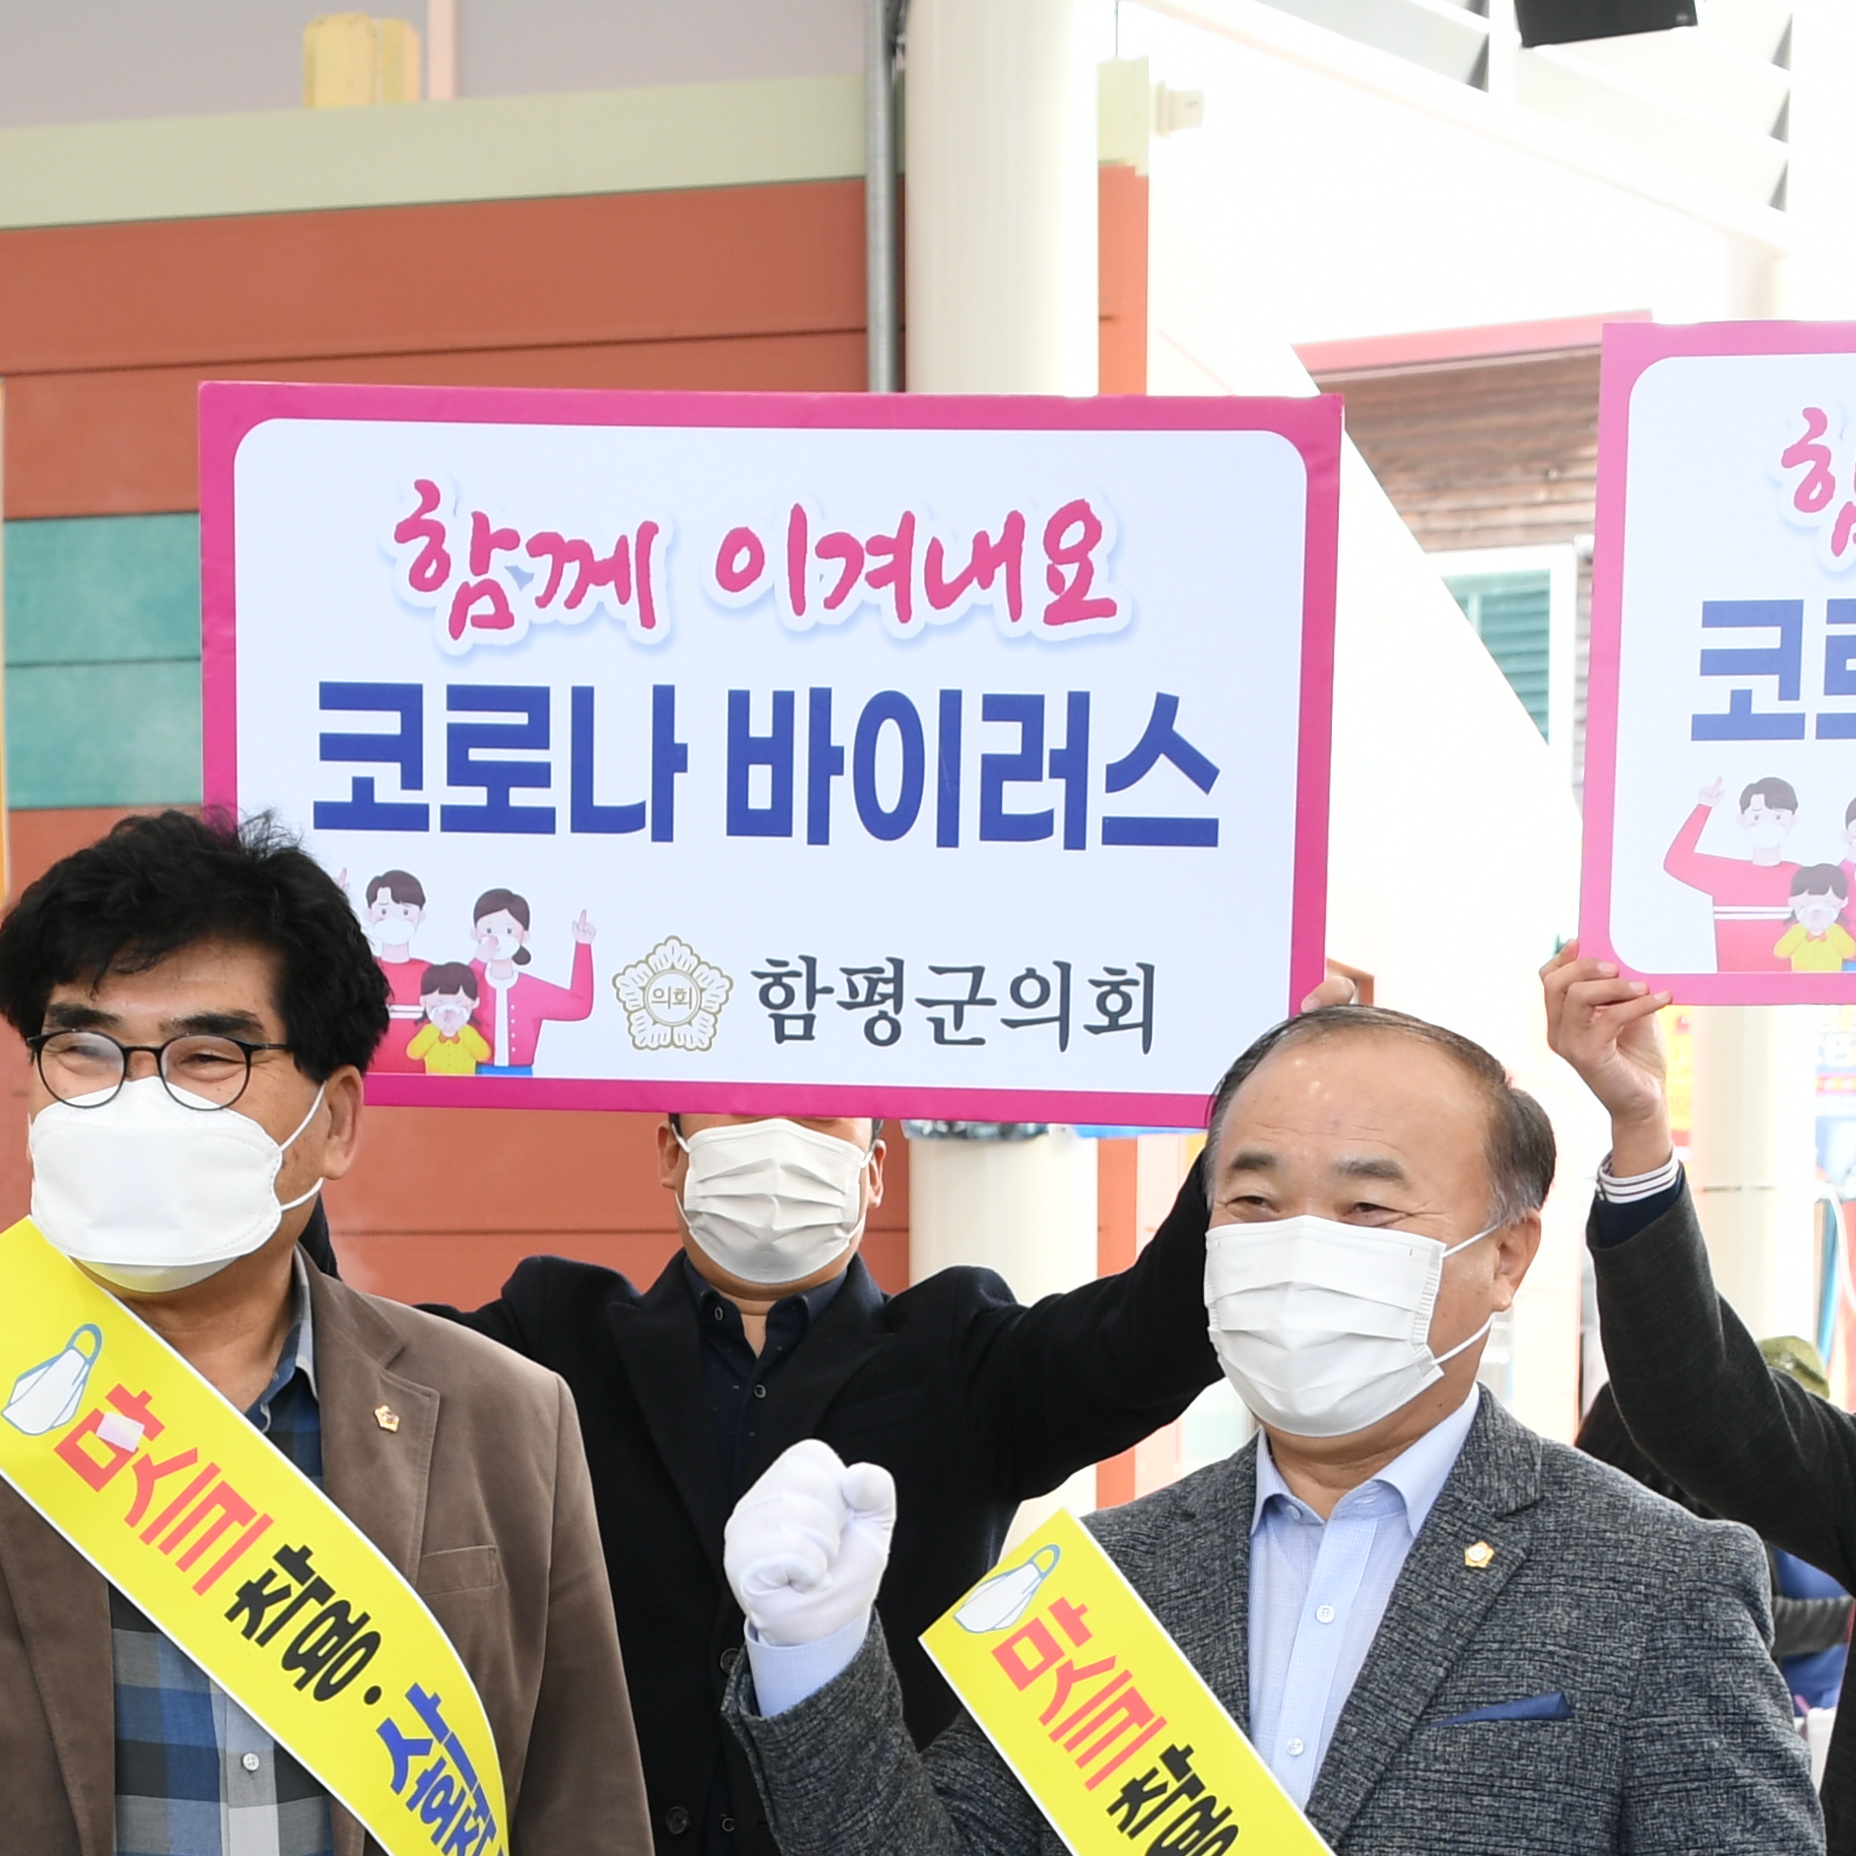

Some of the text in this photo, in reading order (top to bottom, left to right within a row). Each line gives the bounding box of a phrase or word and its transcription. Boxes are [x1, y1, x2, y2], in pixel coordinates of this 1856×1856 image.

[393, 478, 1119, 642] 함께 이겨내요
[312, 680, 1222, 852] 코로나 바이러스
[650, 985, 693, 1011] 의회
[750, 954, 1156, 1056] 함평군의회
[224, 1543, 383, 1704] 착용
[991, 1596, 1168, 1792] 마스크
